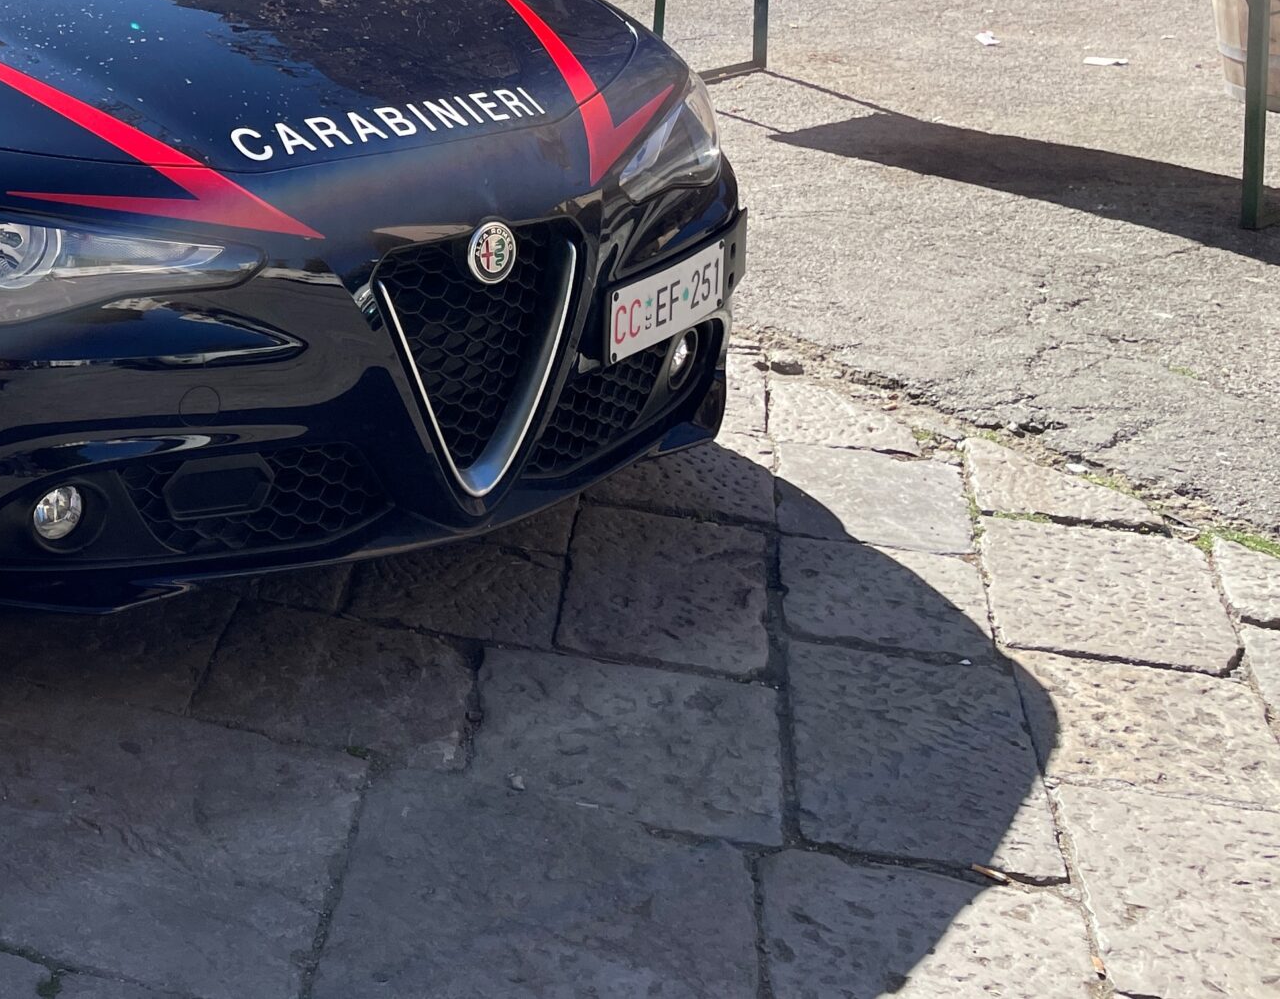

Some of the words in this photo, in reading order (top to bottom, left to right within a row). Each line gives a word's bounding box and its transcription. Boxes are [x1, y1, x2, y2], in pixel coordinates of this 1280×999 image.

[230, 86, 546, 162] CARABINIERI
[476, 232, 489, 257] ALFA
[490, 228, 513, 251] ROMEO
